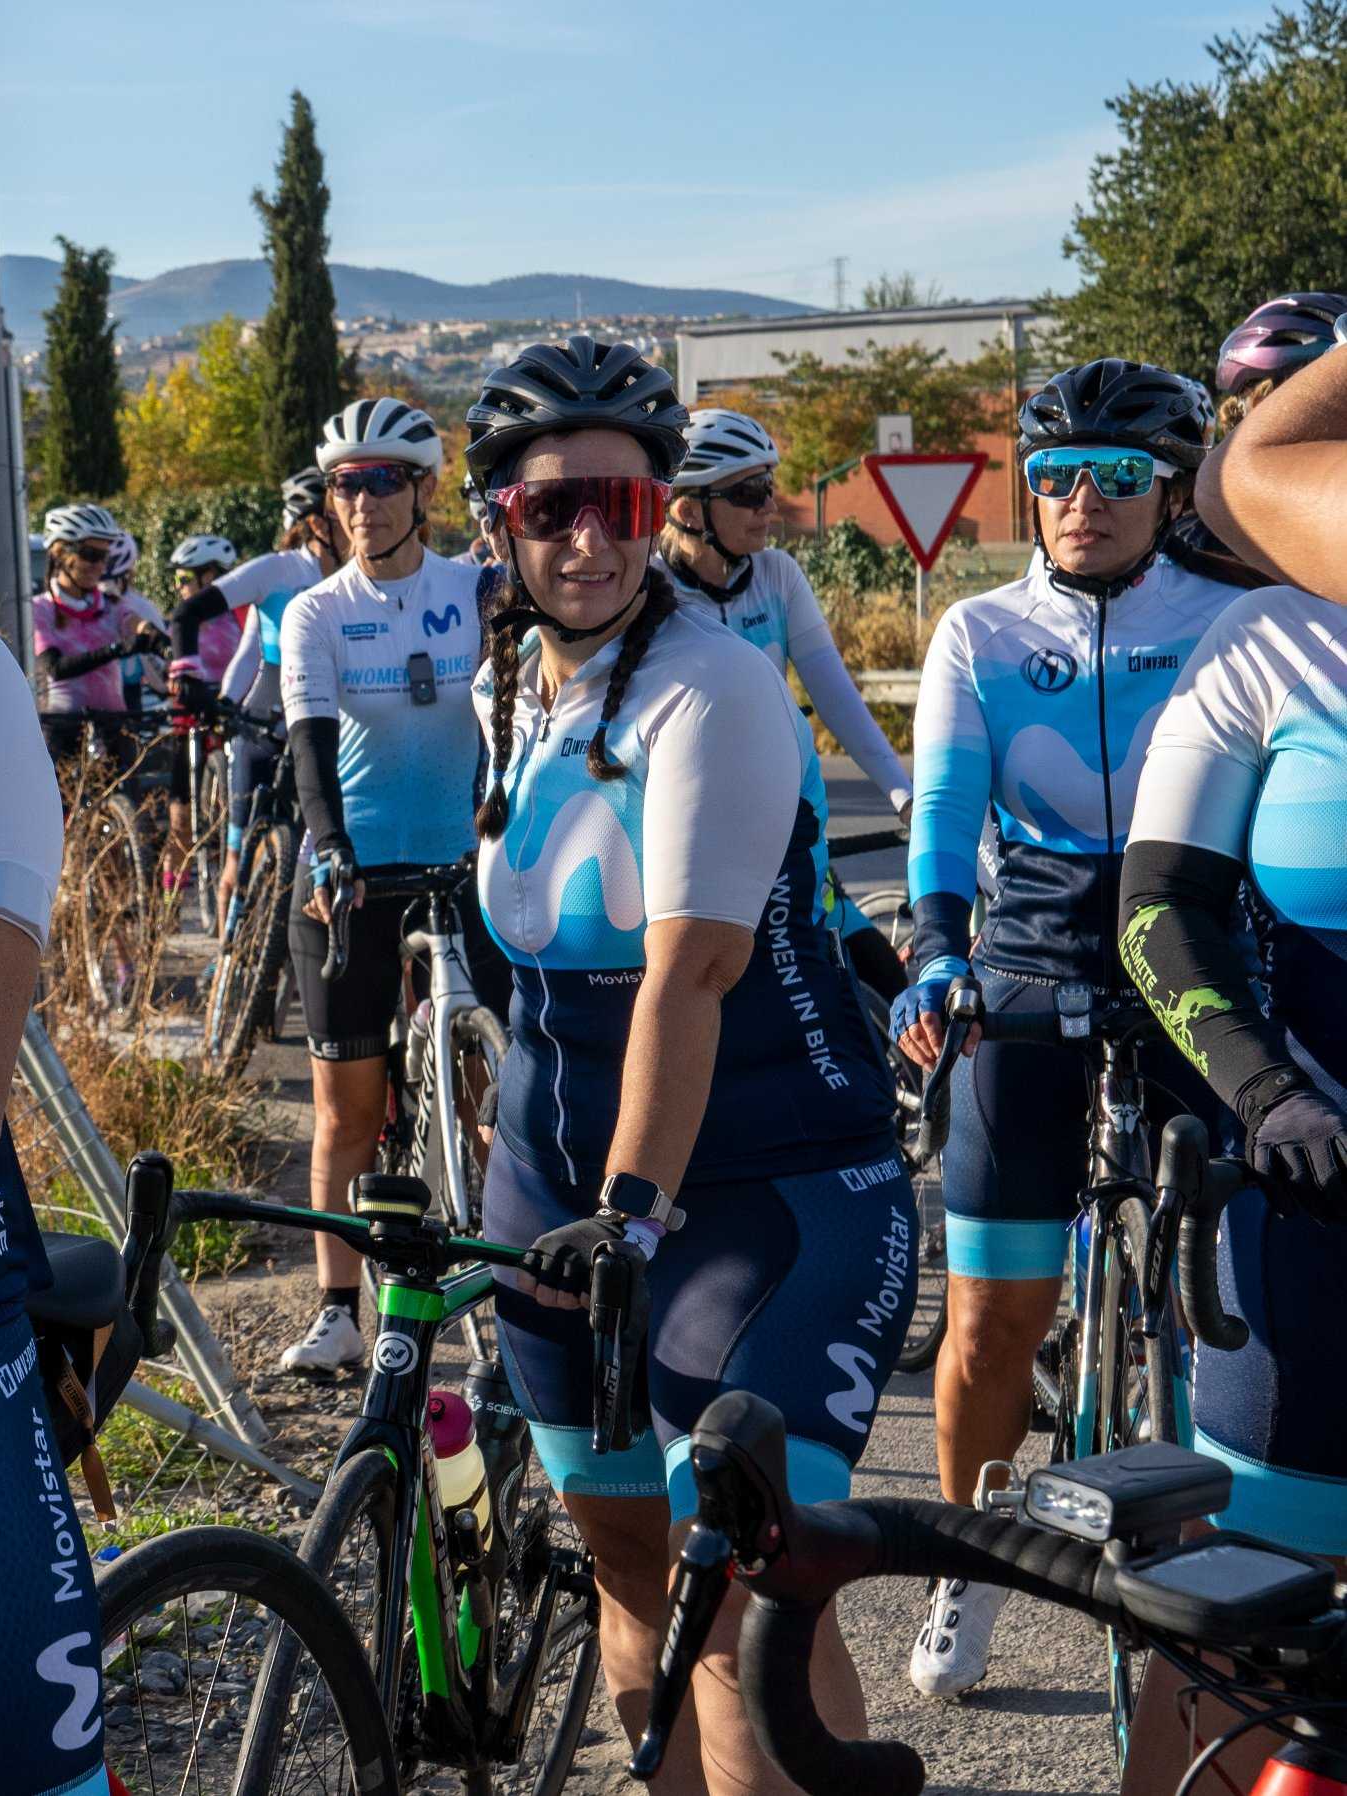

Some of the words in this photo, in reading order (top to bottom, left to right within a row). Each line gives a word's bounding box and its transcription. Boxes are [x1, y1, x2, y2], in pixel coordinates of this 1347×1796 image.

[436, 656, 473, 677] BIKE
[588, 971, 645, 986] Movist
[768, 872, 803, 987] WOMEN
[790, 991, 820, 1023] IN
[805, 1027, 850, 1091] BIKE
[856, 1205, 909, 1338] Movistar
[32, 1406, 84, 1603] Movistar
